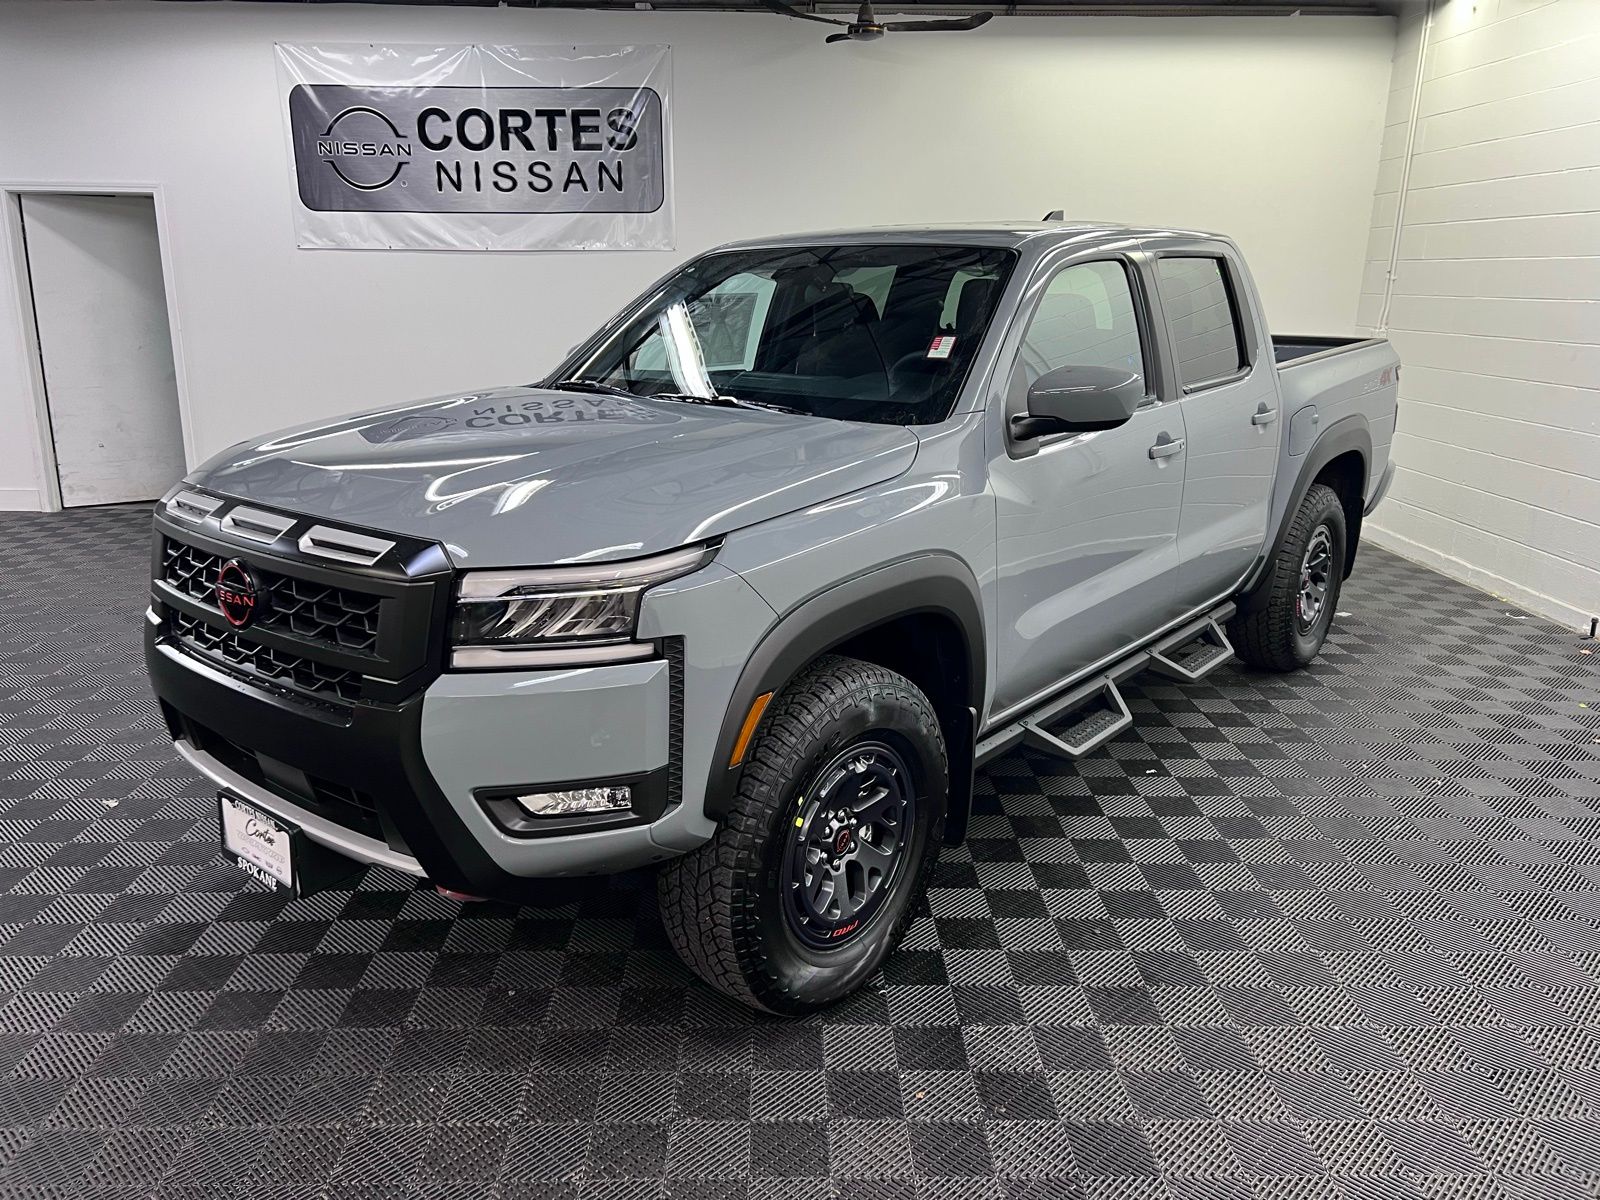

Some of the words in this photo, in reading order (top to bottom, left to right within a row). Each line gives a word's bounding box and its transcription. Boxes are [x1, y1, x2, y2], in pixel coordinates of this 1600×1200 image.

[416, 106, 638, 152] CORTES
[317, 140, 412, 157] NISSAN
[435, 160, 624, 193] NISSAN
[237, 857, 278, 890] SPOKANE
